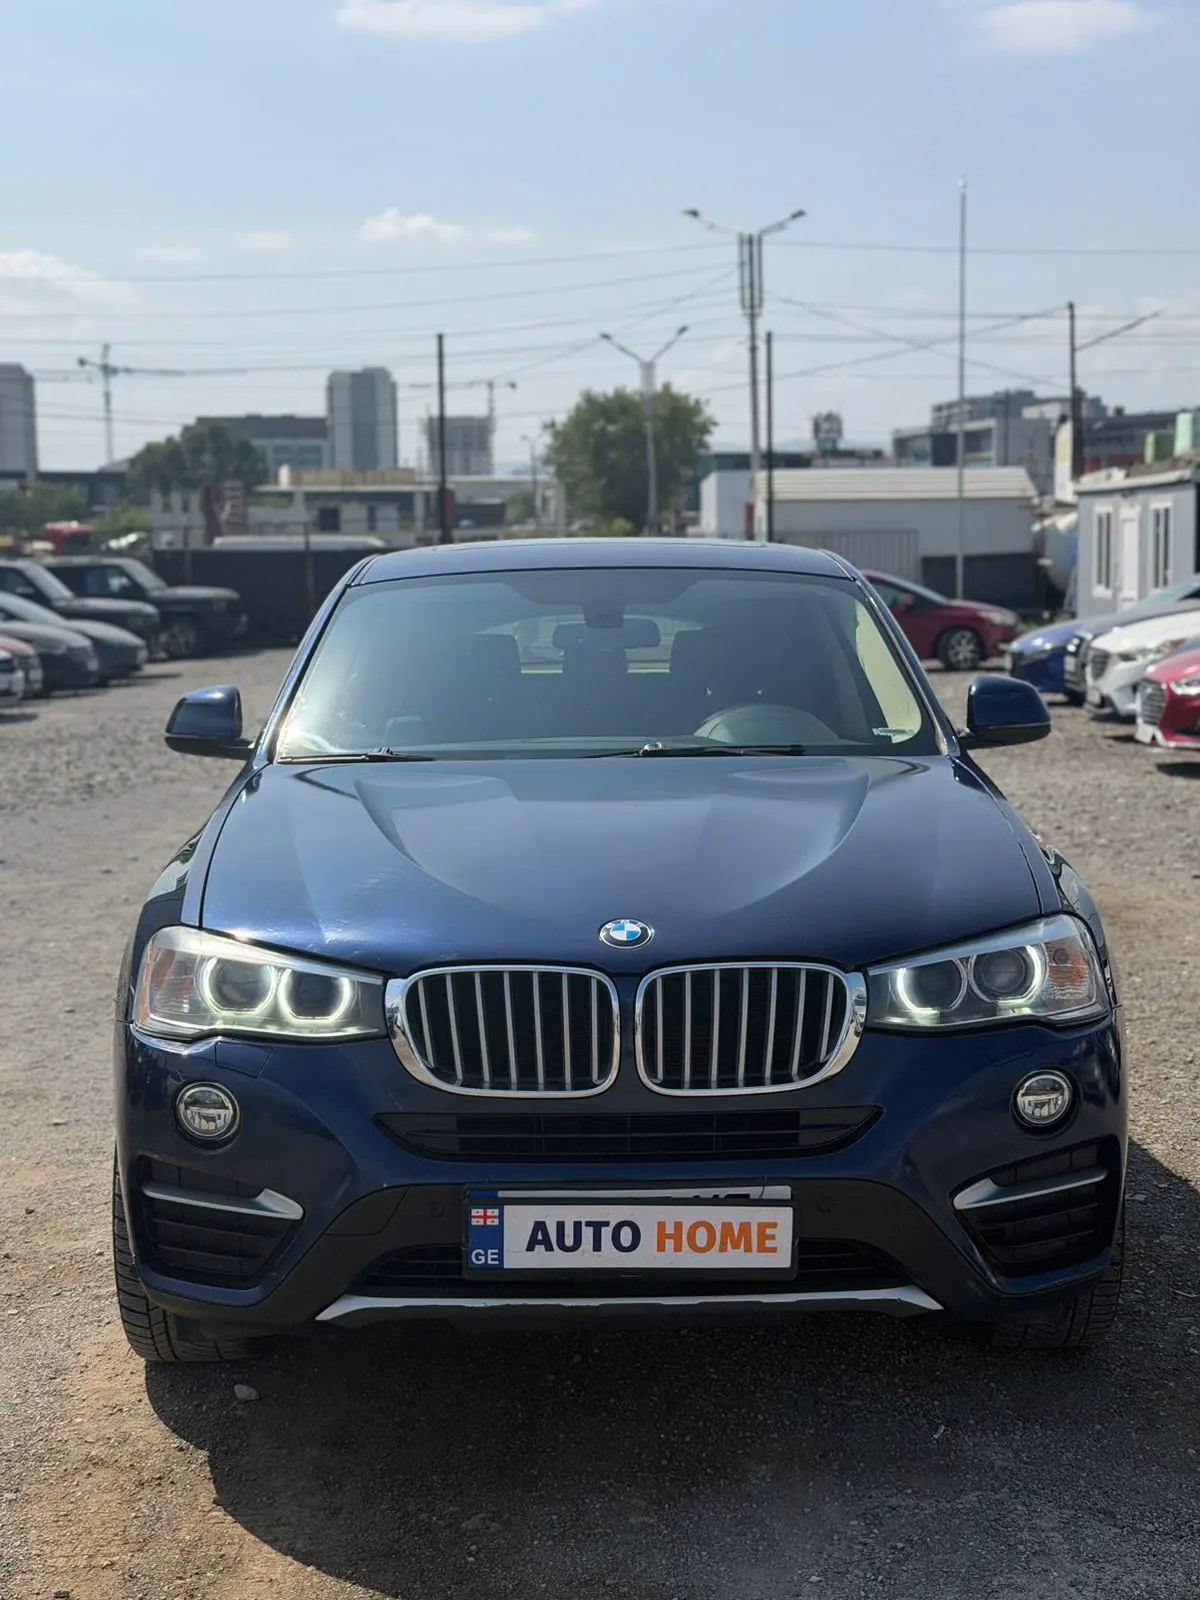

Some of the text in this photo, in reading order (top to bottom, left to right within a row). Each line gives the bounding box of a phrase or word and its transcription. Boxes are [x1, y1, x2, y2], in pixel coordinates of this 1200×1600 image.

[525, 1220, 779, 1253] AUTO HOME
[471, 1249, 499, 1265] GE
